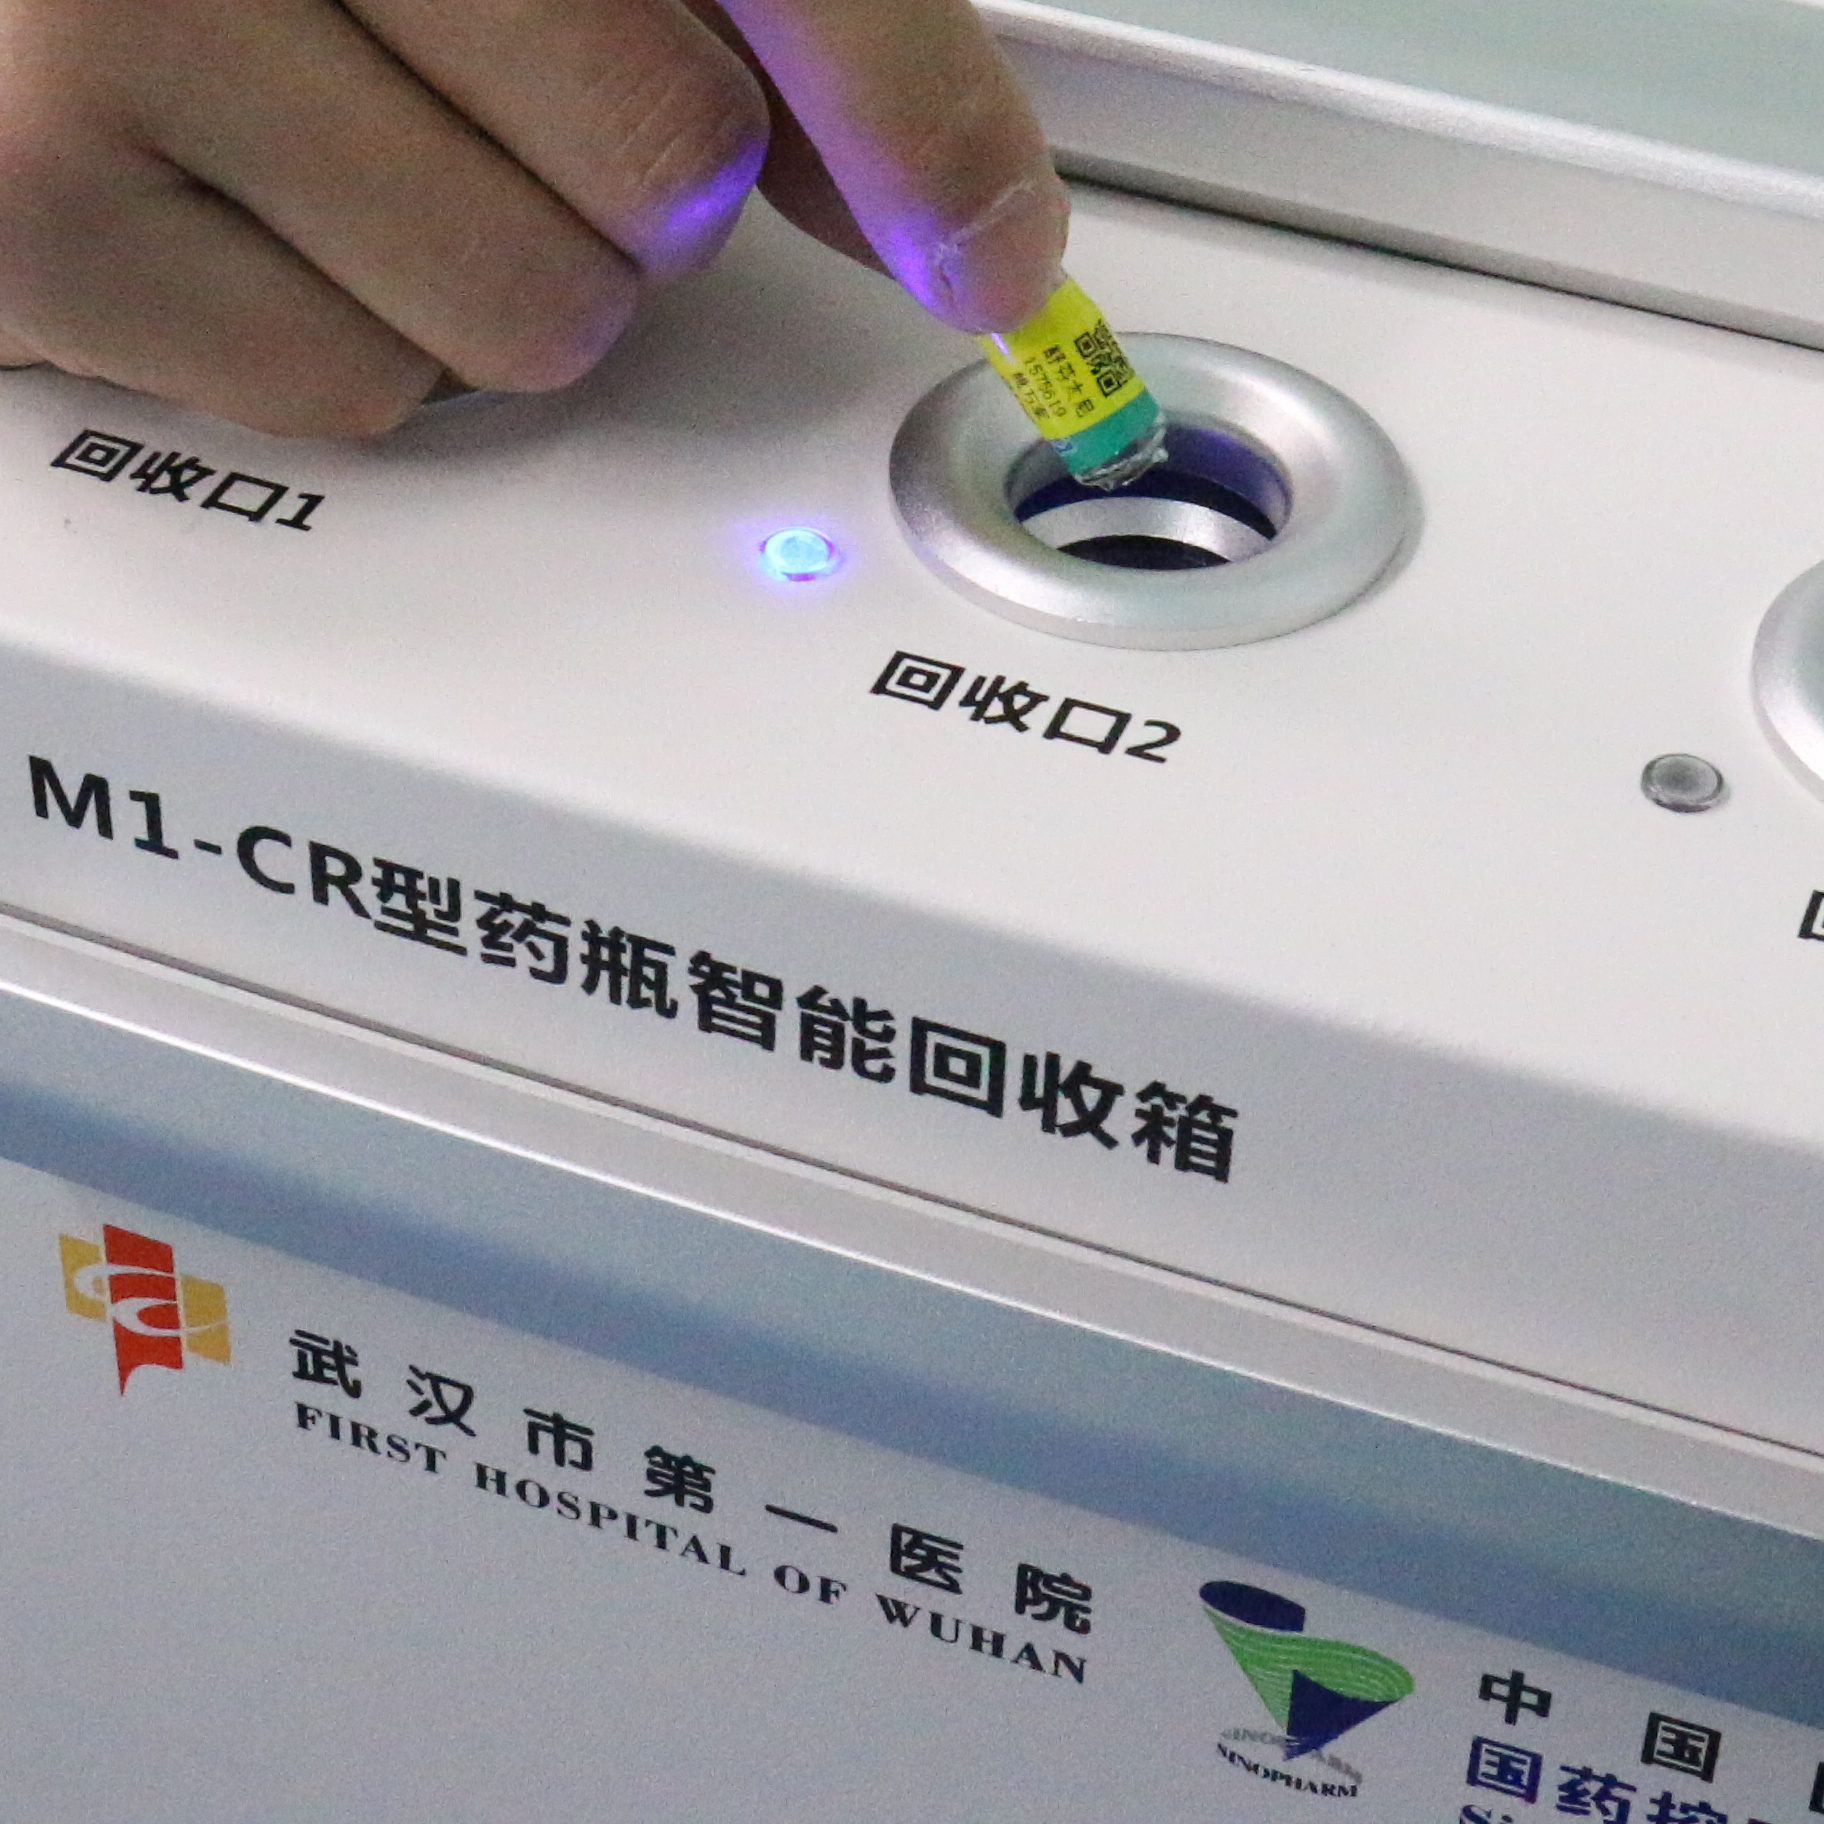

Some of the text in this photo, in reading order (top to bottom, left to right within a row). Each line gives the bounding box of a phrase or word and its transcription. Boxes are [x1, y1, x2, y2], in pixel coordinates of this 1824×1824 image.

[50, 428, 326, 533] 回收口1
[870, 650, 1182, 764] 回收口2
[27, 754, 1239, 1184] M1-CR型药瓶智能回收箱
[288, 1328, 1094, 1636] 武汉市第一医院
[295, 1402, 1088, 1685] FIRST HOSPITAL OF WUHAN
